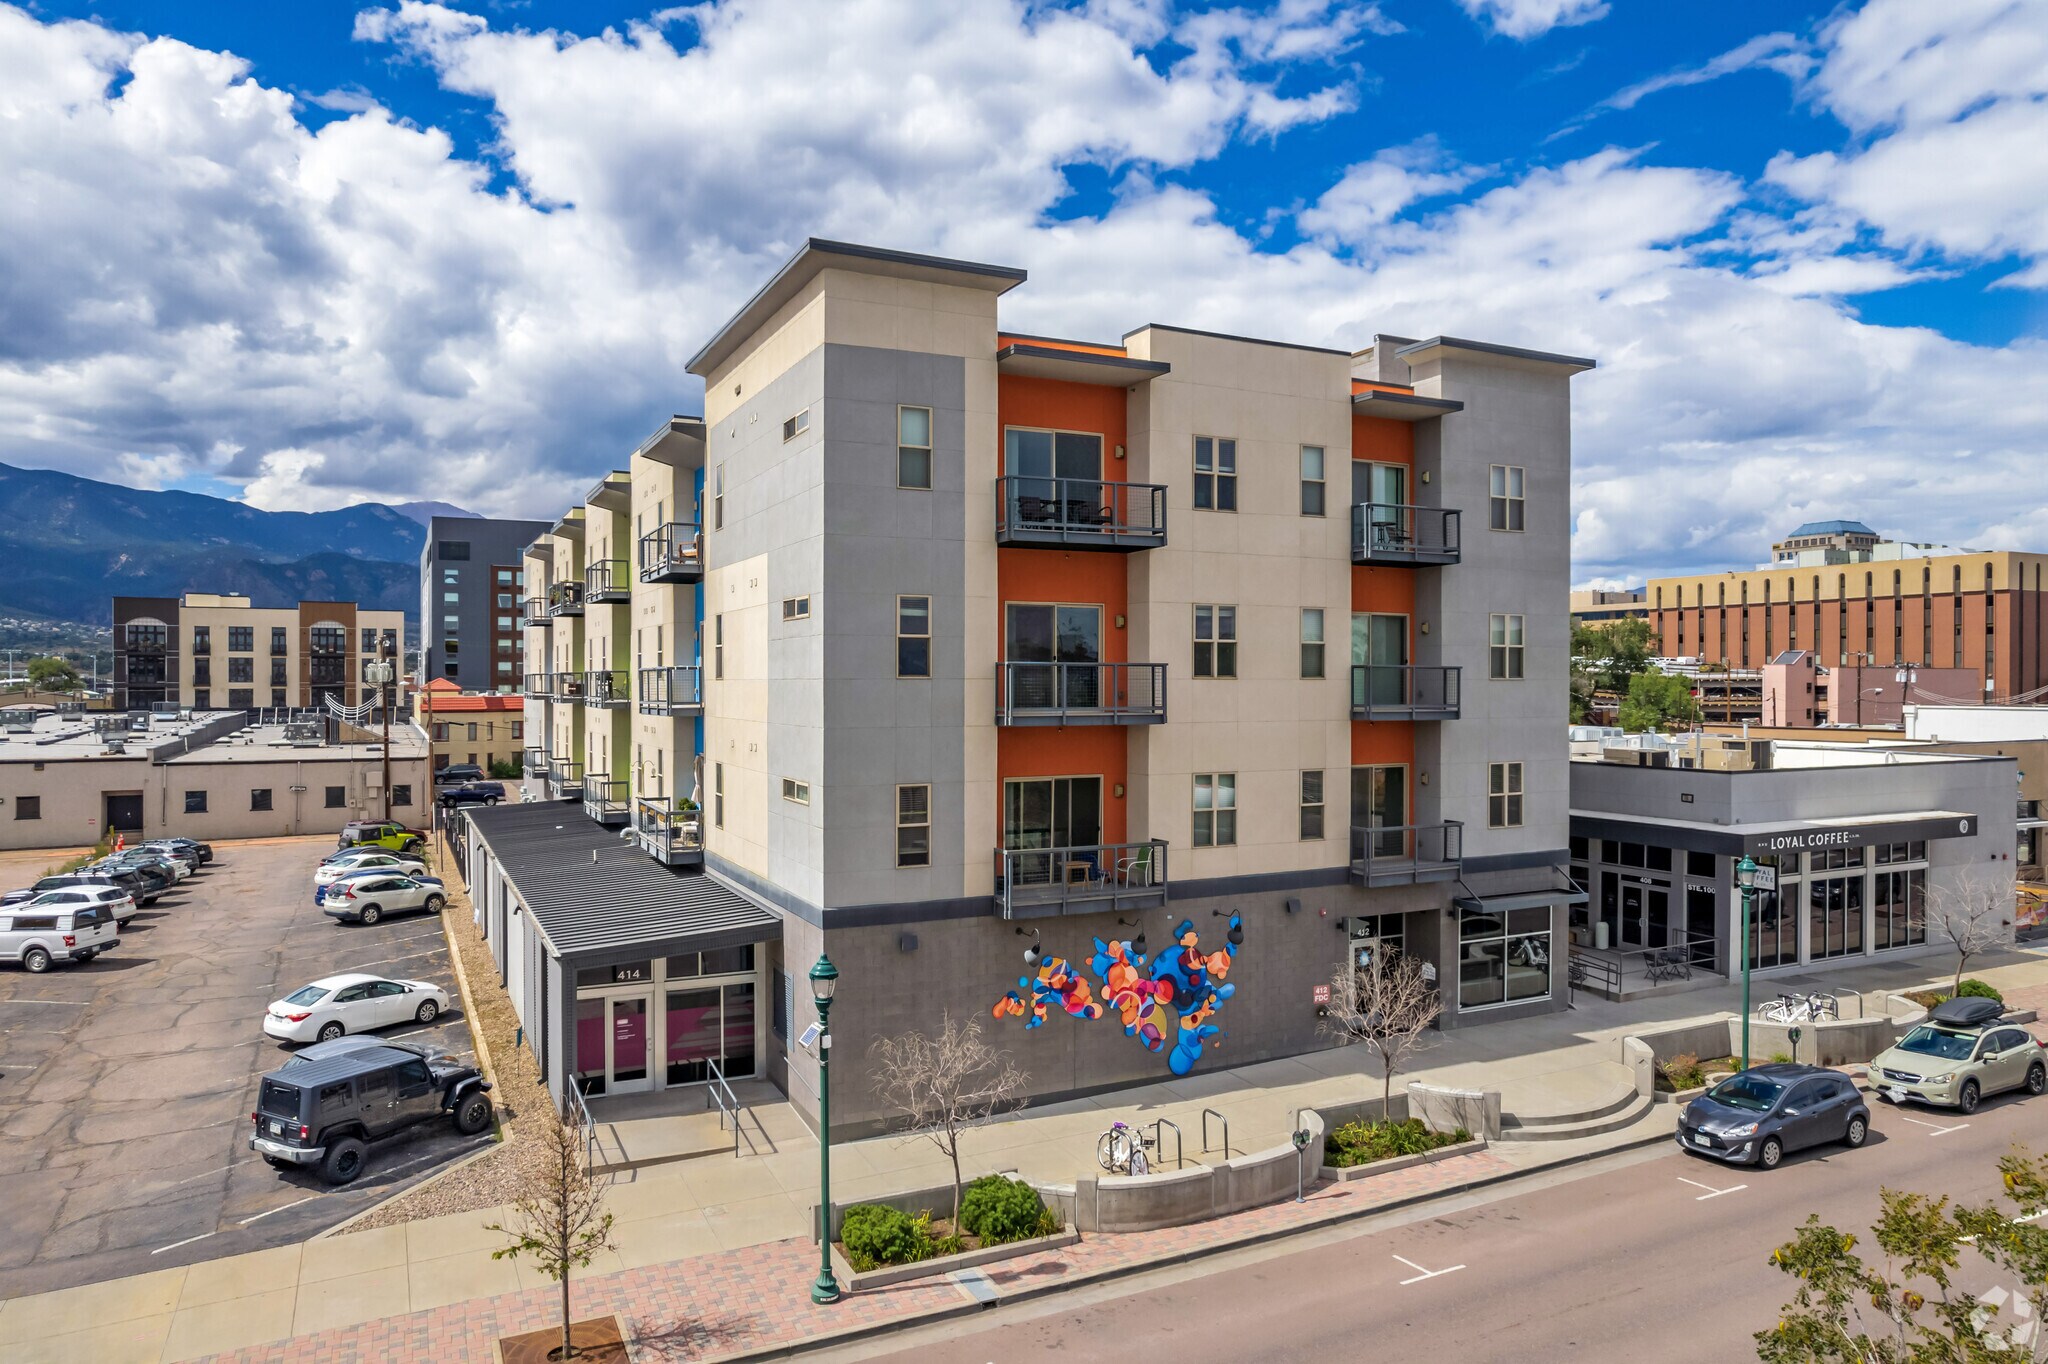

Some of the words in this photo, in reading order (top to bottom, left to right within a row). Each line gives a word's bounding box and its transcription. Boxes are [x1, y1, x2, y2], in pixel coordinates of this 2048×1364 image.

[1771, 836, 1805, 850] LOYAL
[1808, 831, 1849, 846] COFFEE
[1756, 875, 1774, 883] FFEE
[1357, 927, 1370, 937] 412
[617, 969, 640, 980] 414
[1315, 986, 1328, 994] 412
[1314, 994, 1329, 1002] FDC
